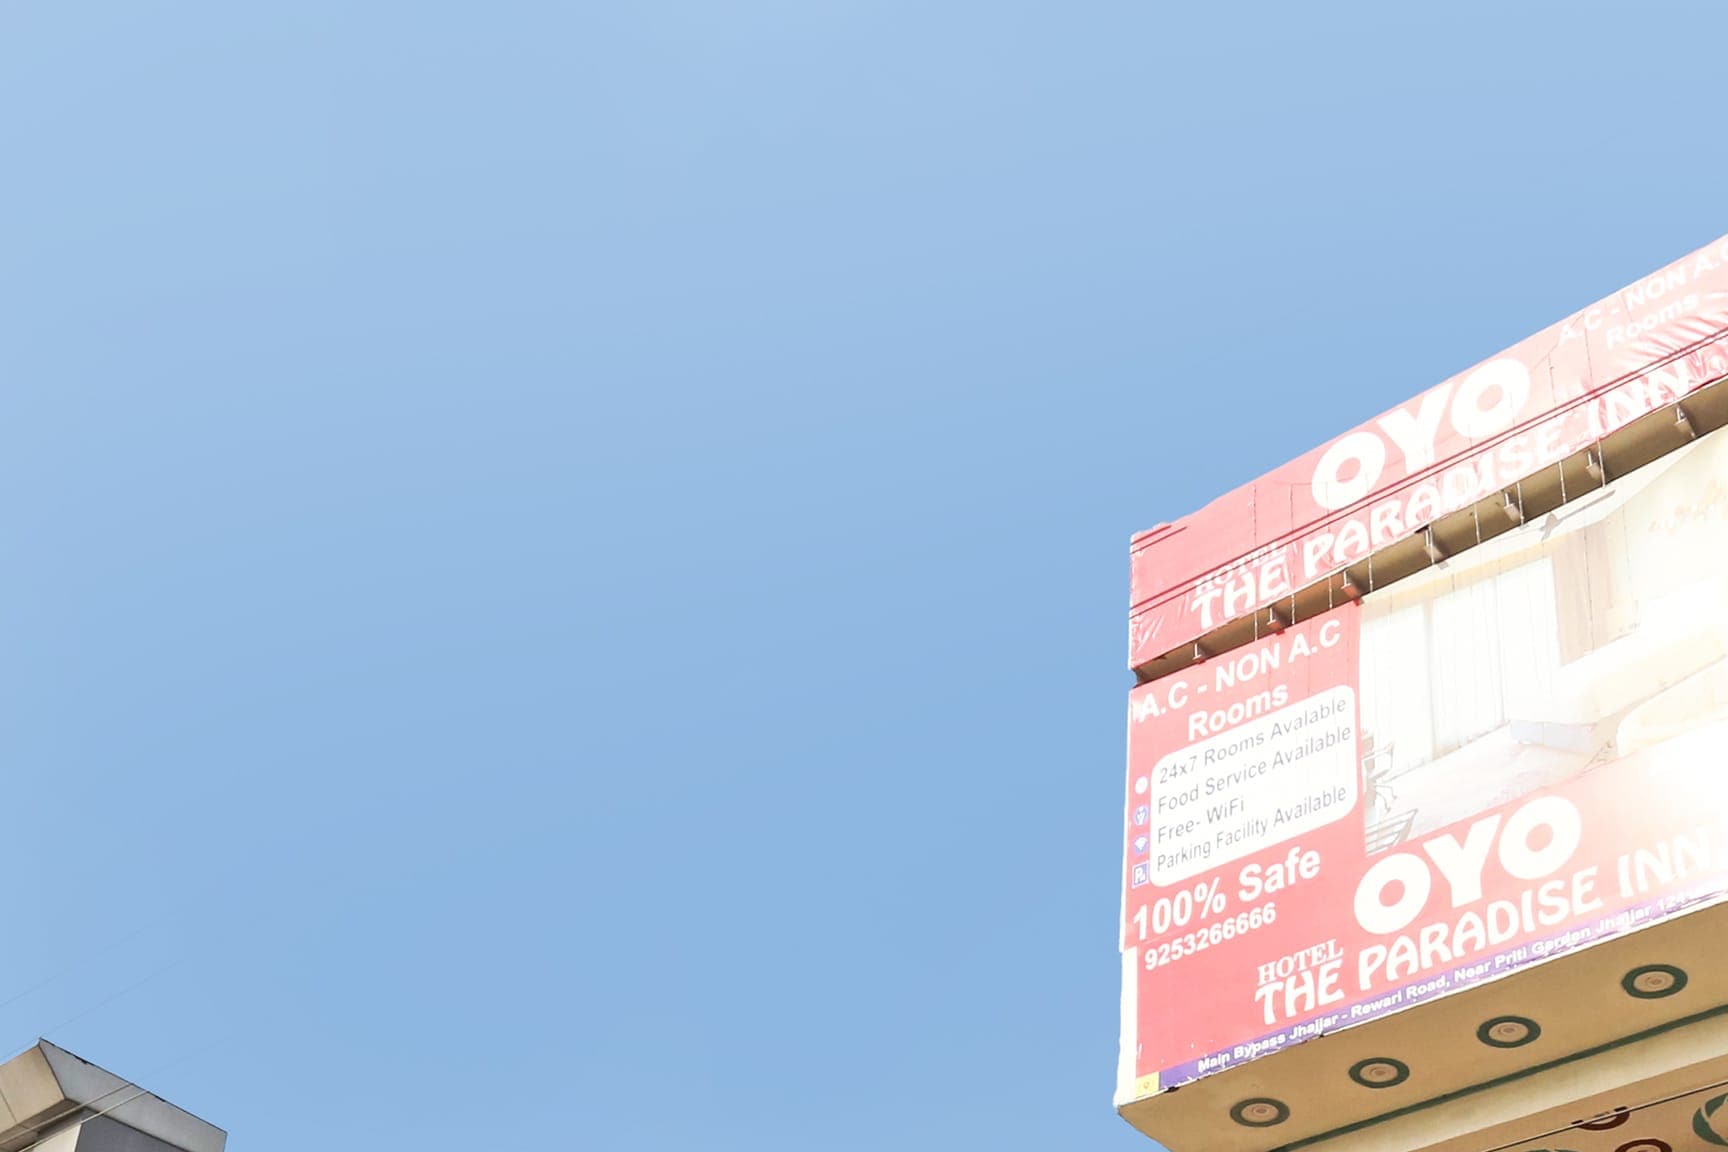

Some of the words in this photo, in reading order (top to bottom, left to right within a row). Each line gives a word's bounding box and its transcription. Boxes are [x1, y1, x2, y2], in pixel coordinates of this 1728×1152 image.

[1607, 294, 1698, 350] Rooms
[1626, 265, 1686, 310] NON
[1311, 357, 1530, 510] OYO
[1191, 557, 1290, 629] THE
[1303, 417, 1572, 578] PARADISE
[1588, 357, 1691, 441] INN
[1137, 681, 1188, 722] A.C
[1215, 644, 1279, 692] NON
[1288, 620, 1341, 664] A.C
[1188, 684, 1289, 741] Rooms
[1158, 783, 1200, 815] Food
[1205, 757, 1267, 797] Service
[1272, 726, 1352, 770] Available
[1159, 755, 1199, 785] 24x7
[1203, 732, 1265, 766] Rooms
[1157, 840, 1212, 872] Parking
[1216, 818, 1268, 850] Facility
[1273, 785, 1347, 828] Available
[1206, 798, 1245, 826] WiFi
[1133, 876, 1227, 941] 100%
[1238, 846, 1321, 902] Safe
[1353, 796, 1582, 935] OYO
[1144, 902, 1277, 970] 9253266666
[1254, 959, 1345, 1026] THE
[1358, 866, 1604, 991] PARADISE
[1617, 827, 1711, 899] INN
[1257, 938, 1344, 986] HOTEL
[1198, 1053, 1231, 1073] Main
[1233, 1033, 1286, 1060] Bypass
[1289, 1013, 1339, 1041] Jhajjar
[1351, 990, 1402, 1019] Rewari
[1454, 961, 1492, 984] Near
[1494, 945, 1527, 969] Priti
[1531, 926, 1592, 956] Garden
